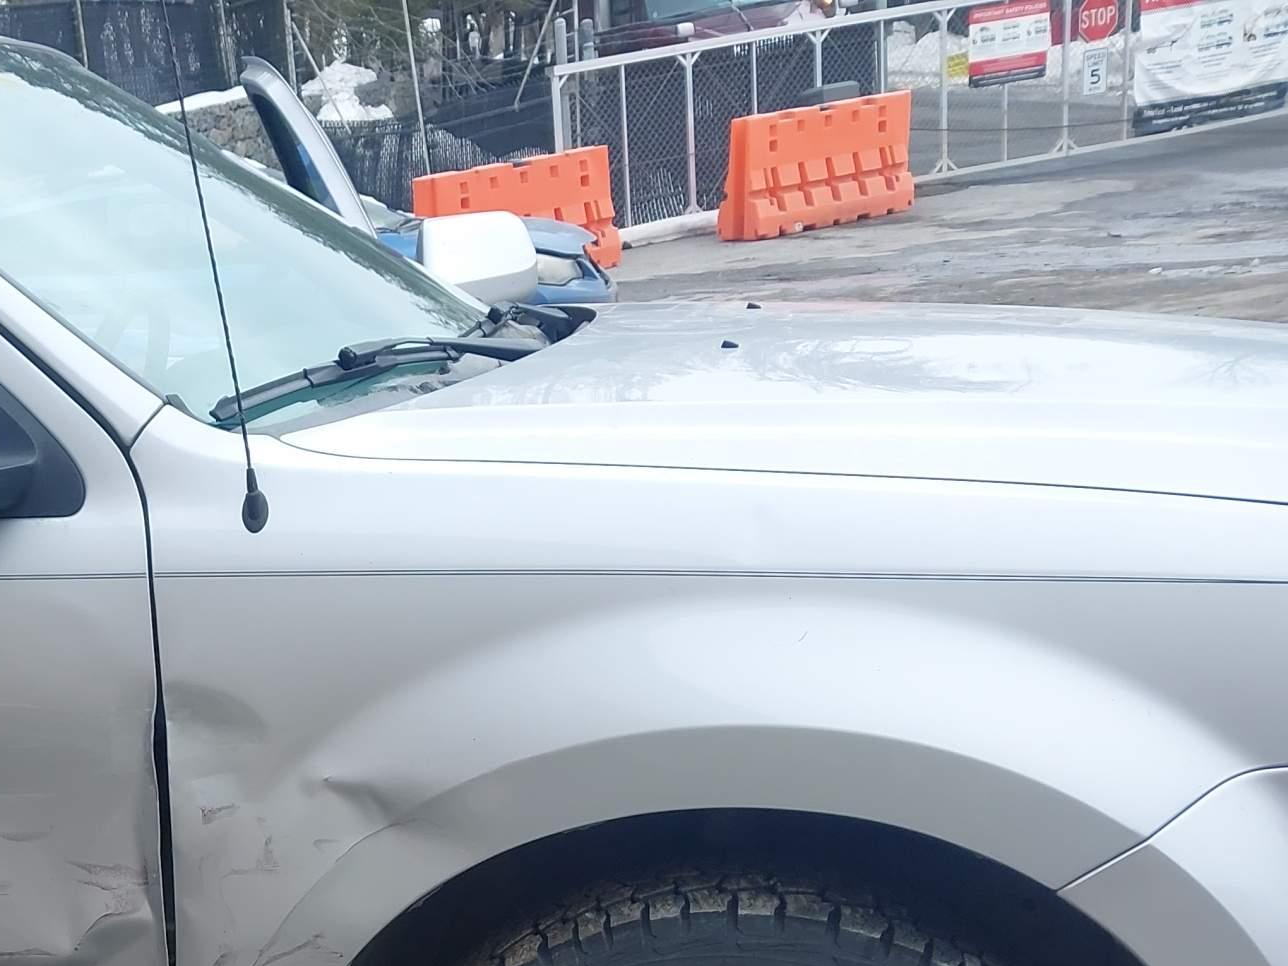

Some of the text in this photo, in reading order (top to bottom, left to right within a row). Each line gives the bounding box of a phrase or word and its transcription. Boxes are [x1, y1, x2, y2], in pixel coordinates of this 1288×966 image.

[1081, 5, 1116, 28] STOP
[1086, 51, 1107, 61] SPEED
[1087, 60, 1105, 68] LIMIT
[1090, 68, 1101, 85] 5
